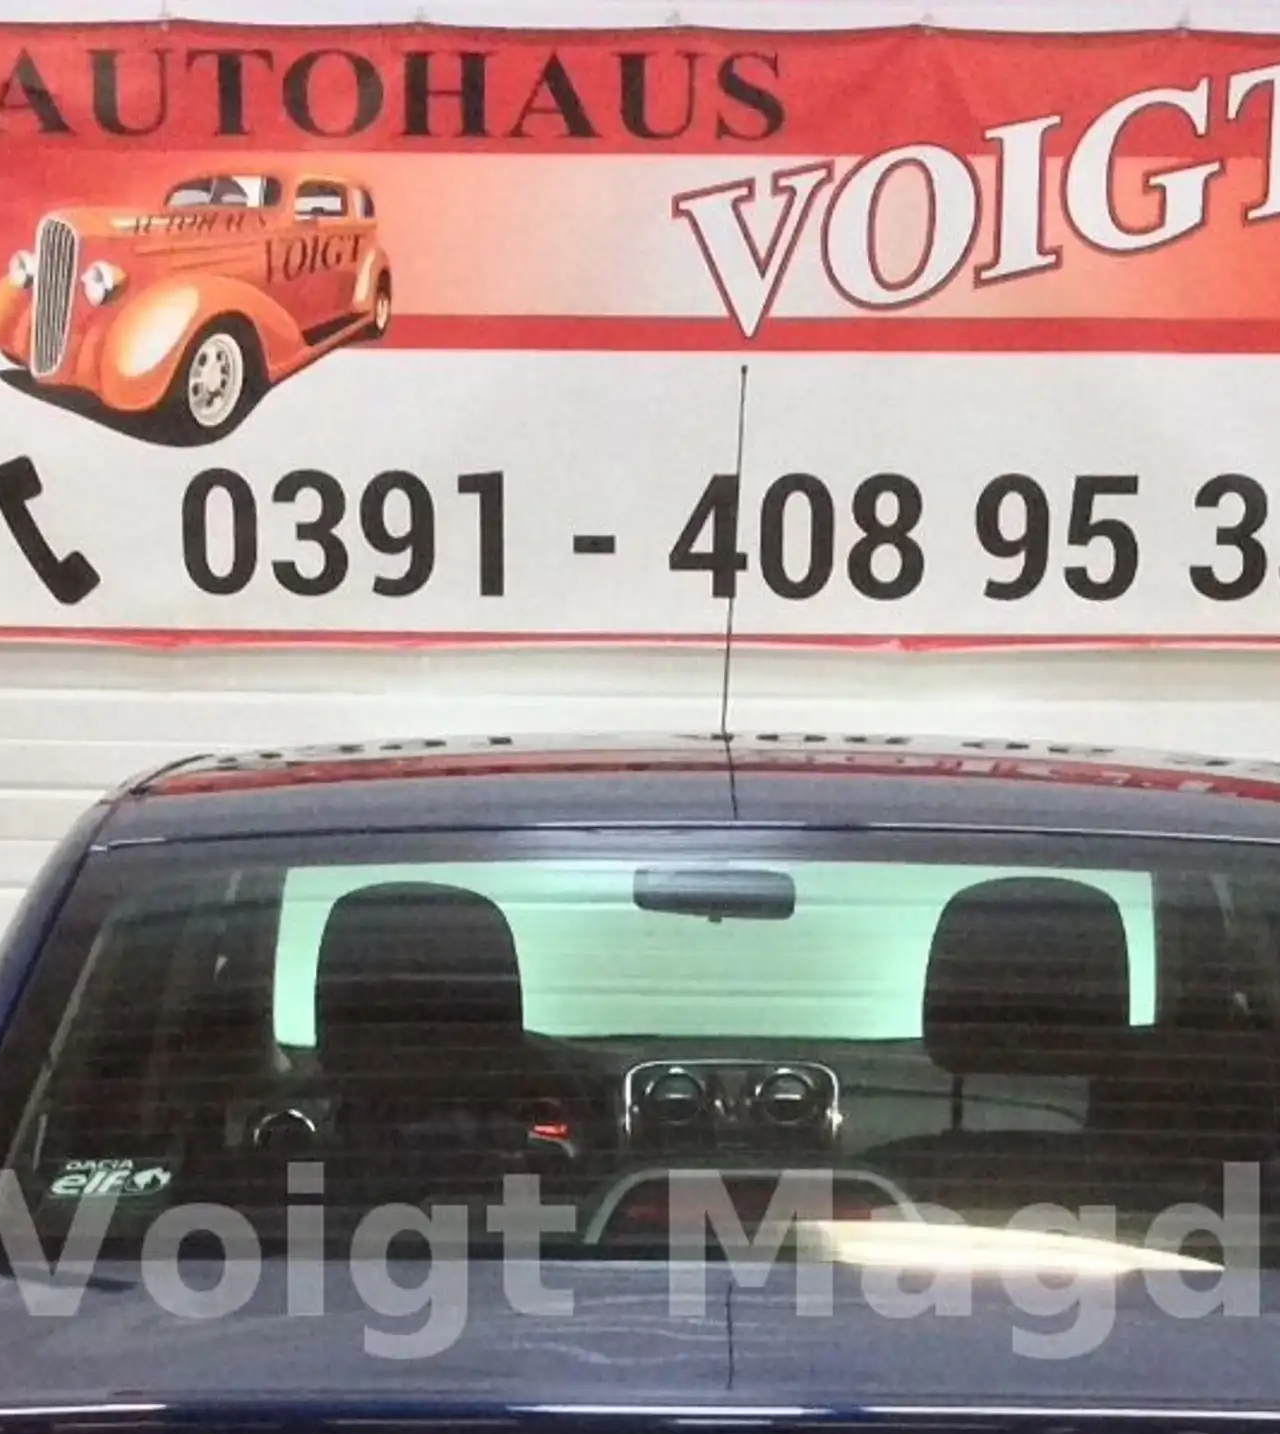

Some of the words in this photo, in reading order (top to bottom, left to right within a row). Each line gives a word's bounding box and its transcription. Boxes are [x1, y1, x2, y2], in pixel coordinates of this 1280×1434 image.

[265, 232, 367, 286] VOIGT
[182, 467, 505, 598] 0391
[573, 535, 616, 555] -
[669, 472, 925, 601] 408
[974, 473, 1139, 602] 95
[50, 1170, 132, 1195] elf
